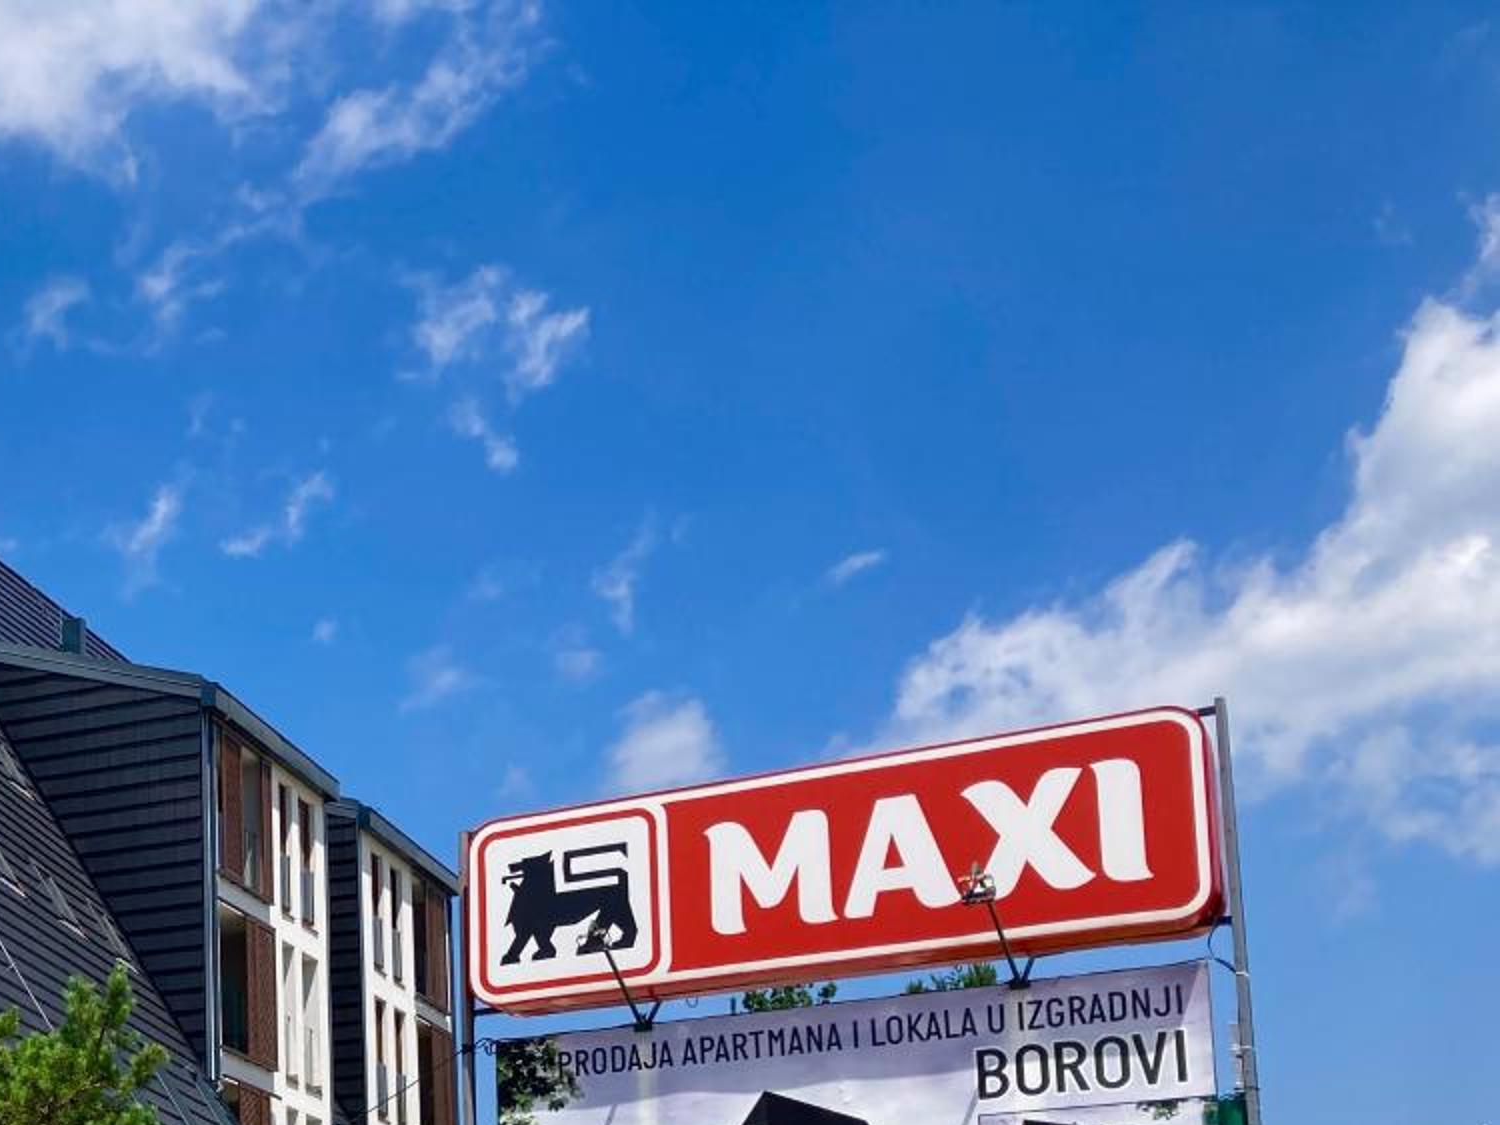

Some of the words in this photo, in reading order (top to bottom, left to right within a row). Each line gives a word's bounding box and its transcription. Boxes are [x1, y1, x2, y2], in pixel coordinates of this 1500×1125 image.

[705, 757, 1154, 935] MAXI
[557, 1039, 674, 1077] PRODAJA
[681, 1021, 843, 1066] APARTMANA
[852, 1020, 860, 1049] I
[870, 1007, 978, 1048] LOKALA
[987, 1003, 1006, 1034] U
[1017, 983, 1185, 1032] IZGRADNJI
[974, 1028, 1189, 1101] BOROVI
